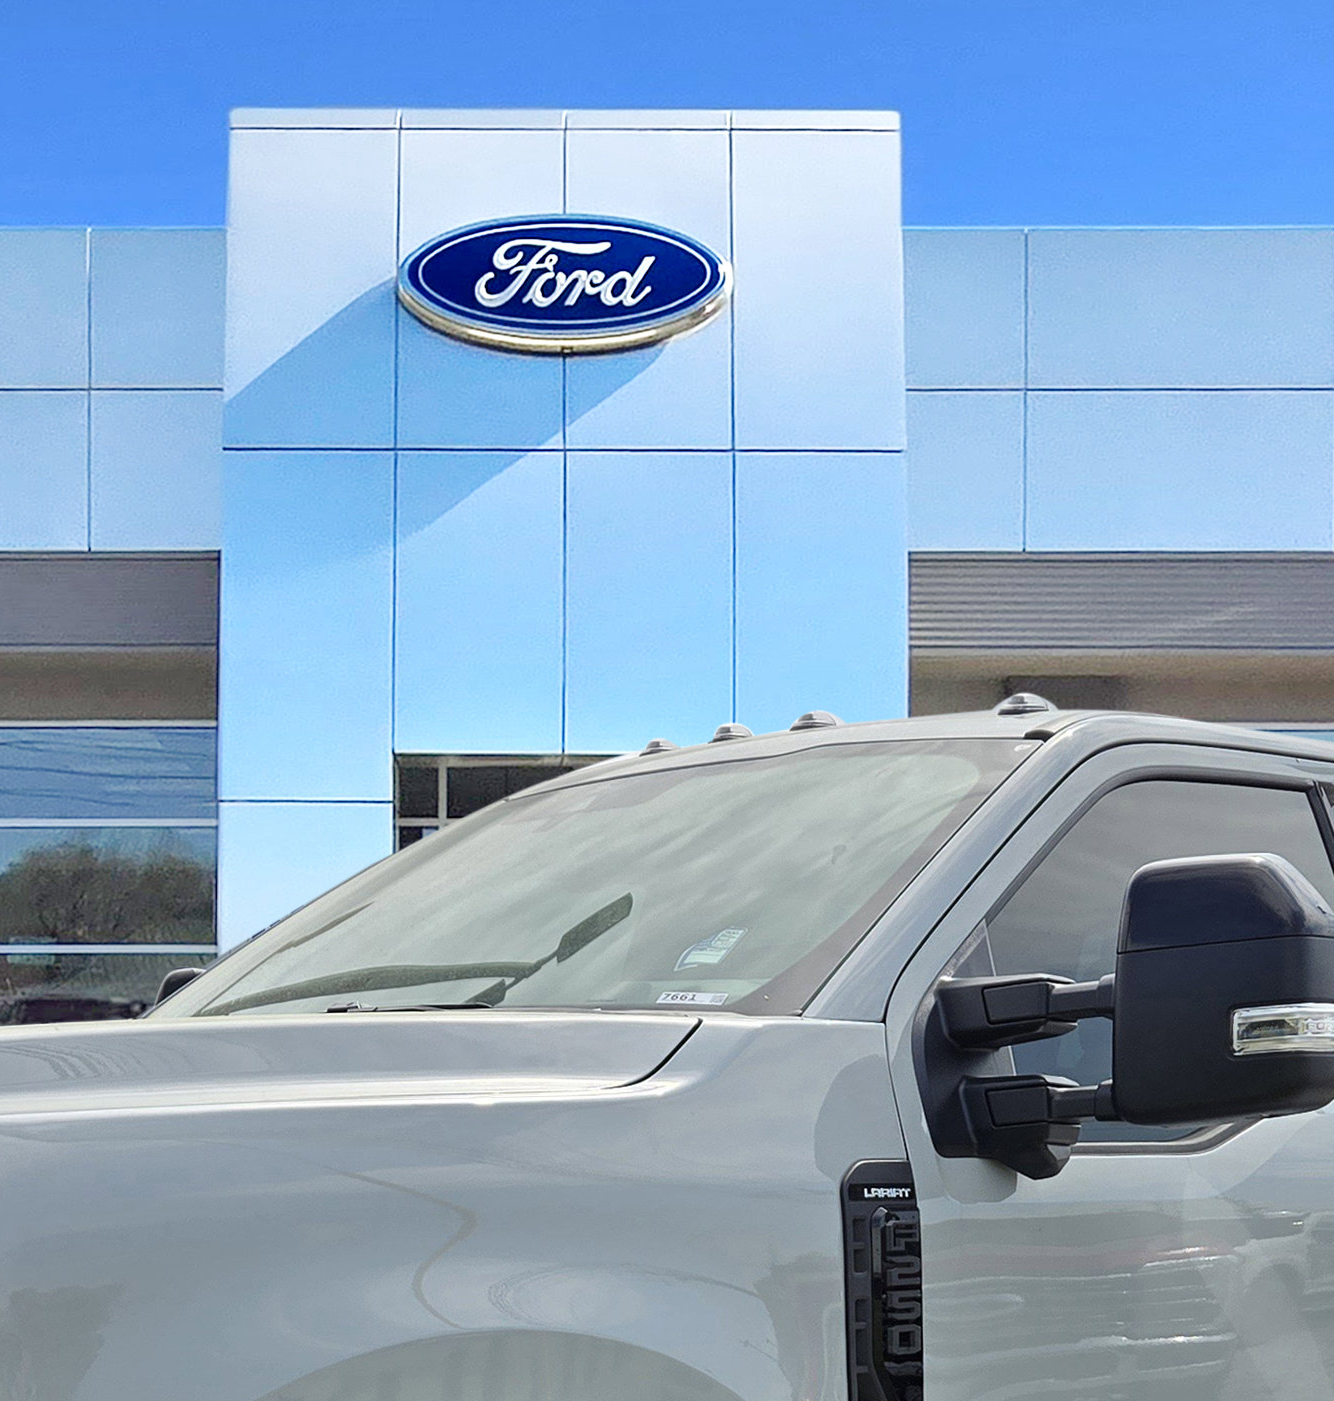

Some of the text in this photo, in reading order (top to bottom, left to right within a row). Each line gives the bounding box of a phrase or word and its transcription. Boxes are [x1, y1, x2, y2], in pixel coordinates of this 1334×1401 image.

[475, 238, 656, 308] Ford
[661, 993, 697, 1001] 7661
[864, 1187, 911, 1198] LARIAT
